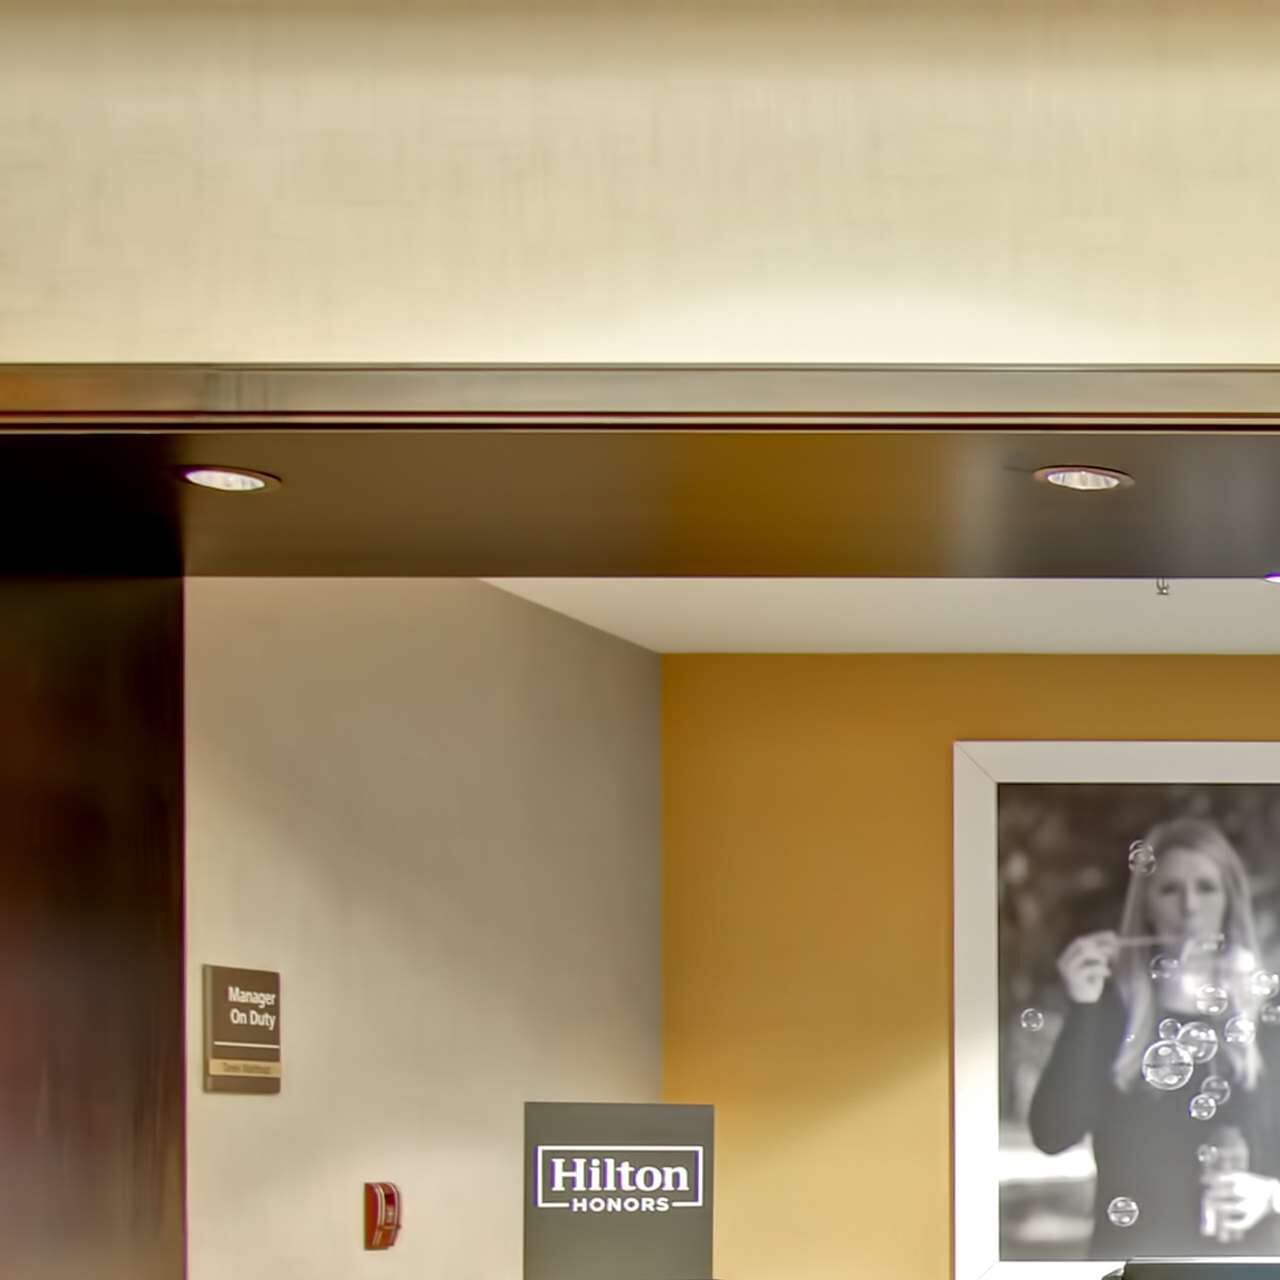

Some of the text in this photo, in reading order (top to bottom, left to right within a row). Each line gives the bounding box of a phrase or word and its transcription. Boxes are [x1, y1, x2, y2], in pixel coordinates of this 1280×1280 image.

[228, 986, 276, 1008] Manager
[230, 1008, 276, 1031] On Duty
[551, 1157, 691, 1192] Hilton
[572, 1197, 670, 1213] HONORS
